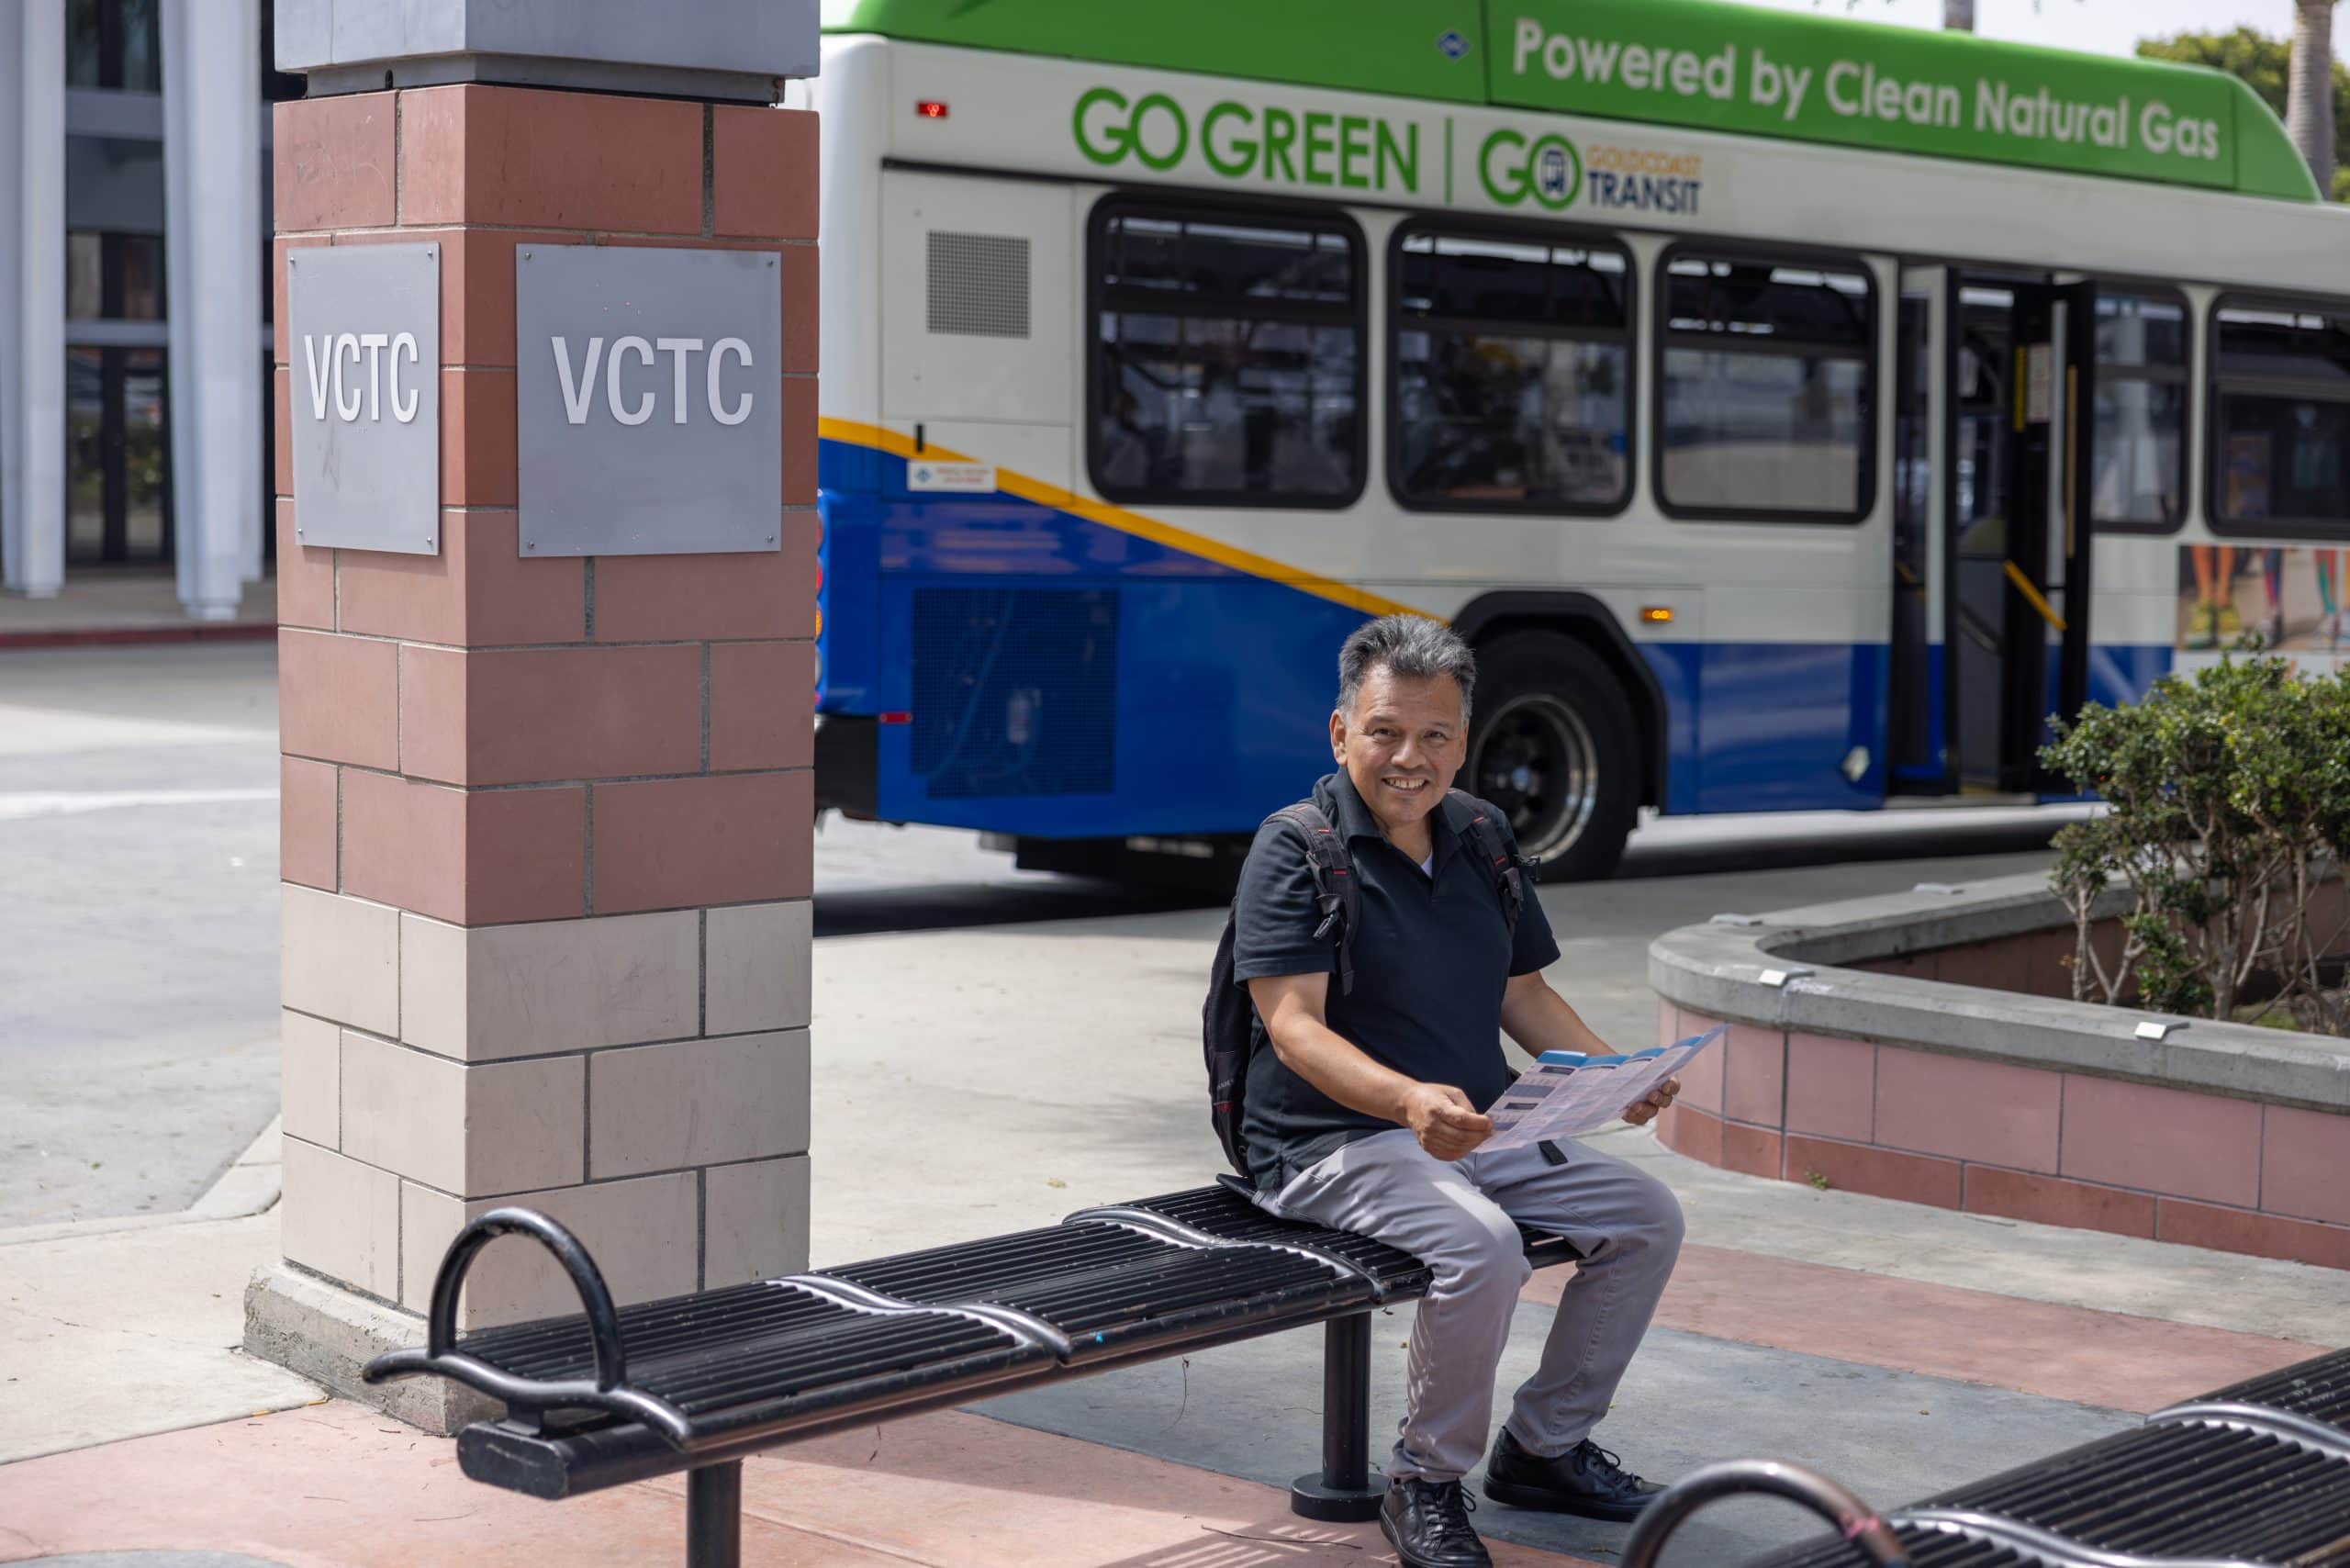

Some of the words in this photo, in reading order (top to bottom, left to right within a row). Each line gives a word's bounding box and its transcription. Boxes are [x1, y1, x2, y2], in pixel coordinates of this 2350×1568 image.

[1512, 17, 1737, 101] Powered
[1749, 47, 1813, 122] by
[1824, 59, 1962, 129] Clean
[1974, 77, 2130, 149] Natural
[2139, 101, 2220, 161] Gas
[1072, 85, 1190, 172] GO
[1200, 101, 1419, 195] GREEN
[1478, 129, 1583, 211] GO
[1586, 170, 1703, 216] TRANSIT
[304, 331, 420, 423] VCTC
[551, 334, 754, 426] VCTC
